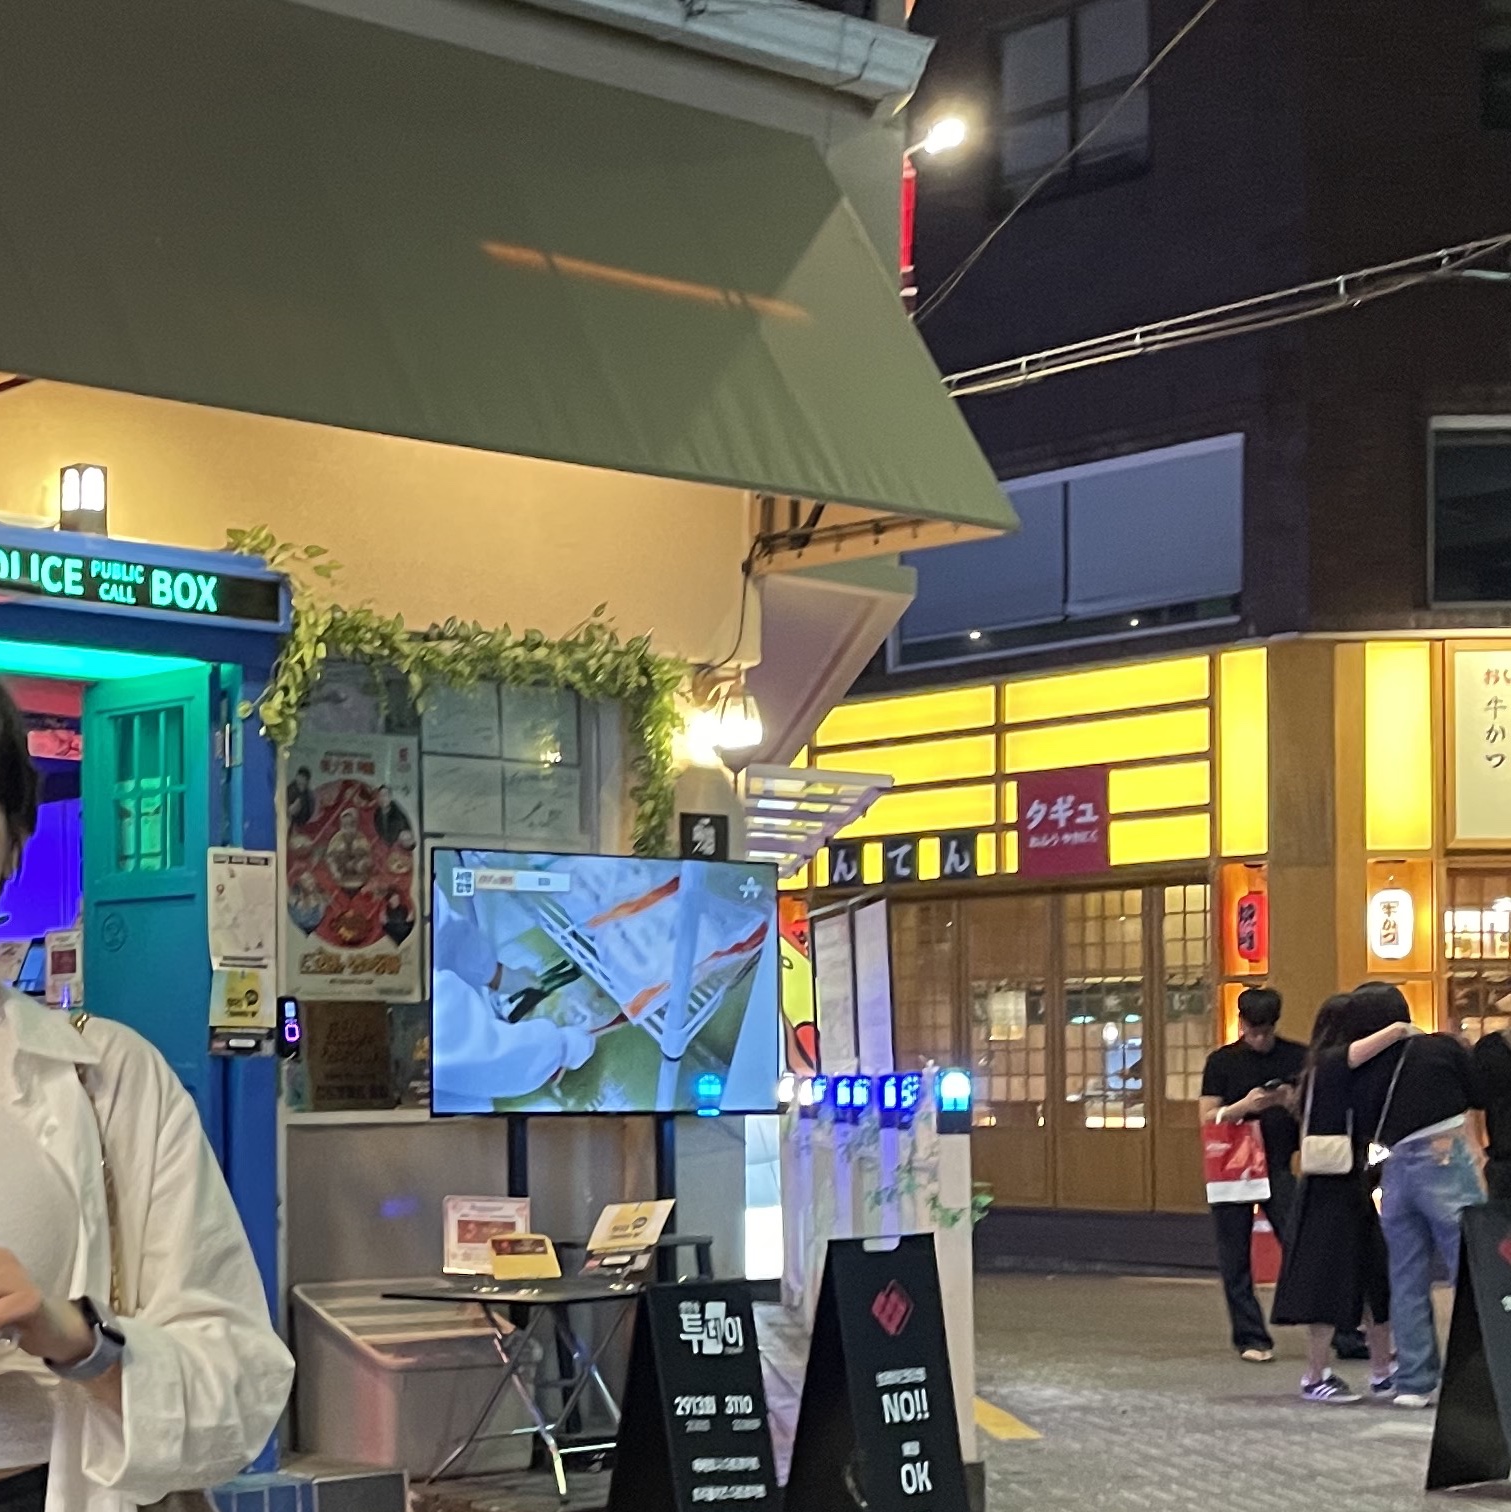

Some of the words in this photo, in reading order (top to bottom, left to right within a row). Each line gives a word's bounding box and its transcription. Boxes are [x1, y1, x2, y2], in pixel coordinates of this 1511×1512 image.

[91, 559, 145, 584] PUBLIC
[99, 583, 137, 604] CALL
[151, 569, 218, 613] BOX
[881, 1388, 930, 1424] NO!!
[900, 1460, 933, 1495] OK
